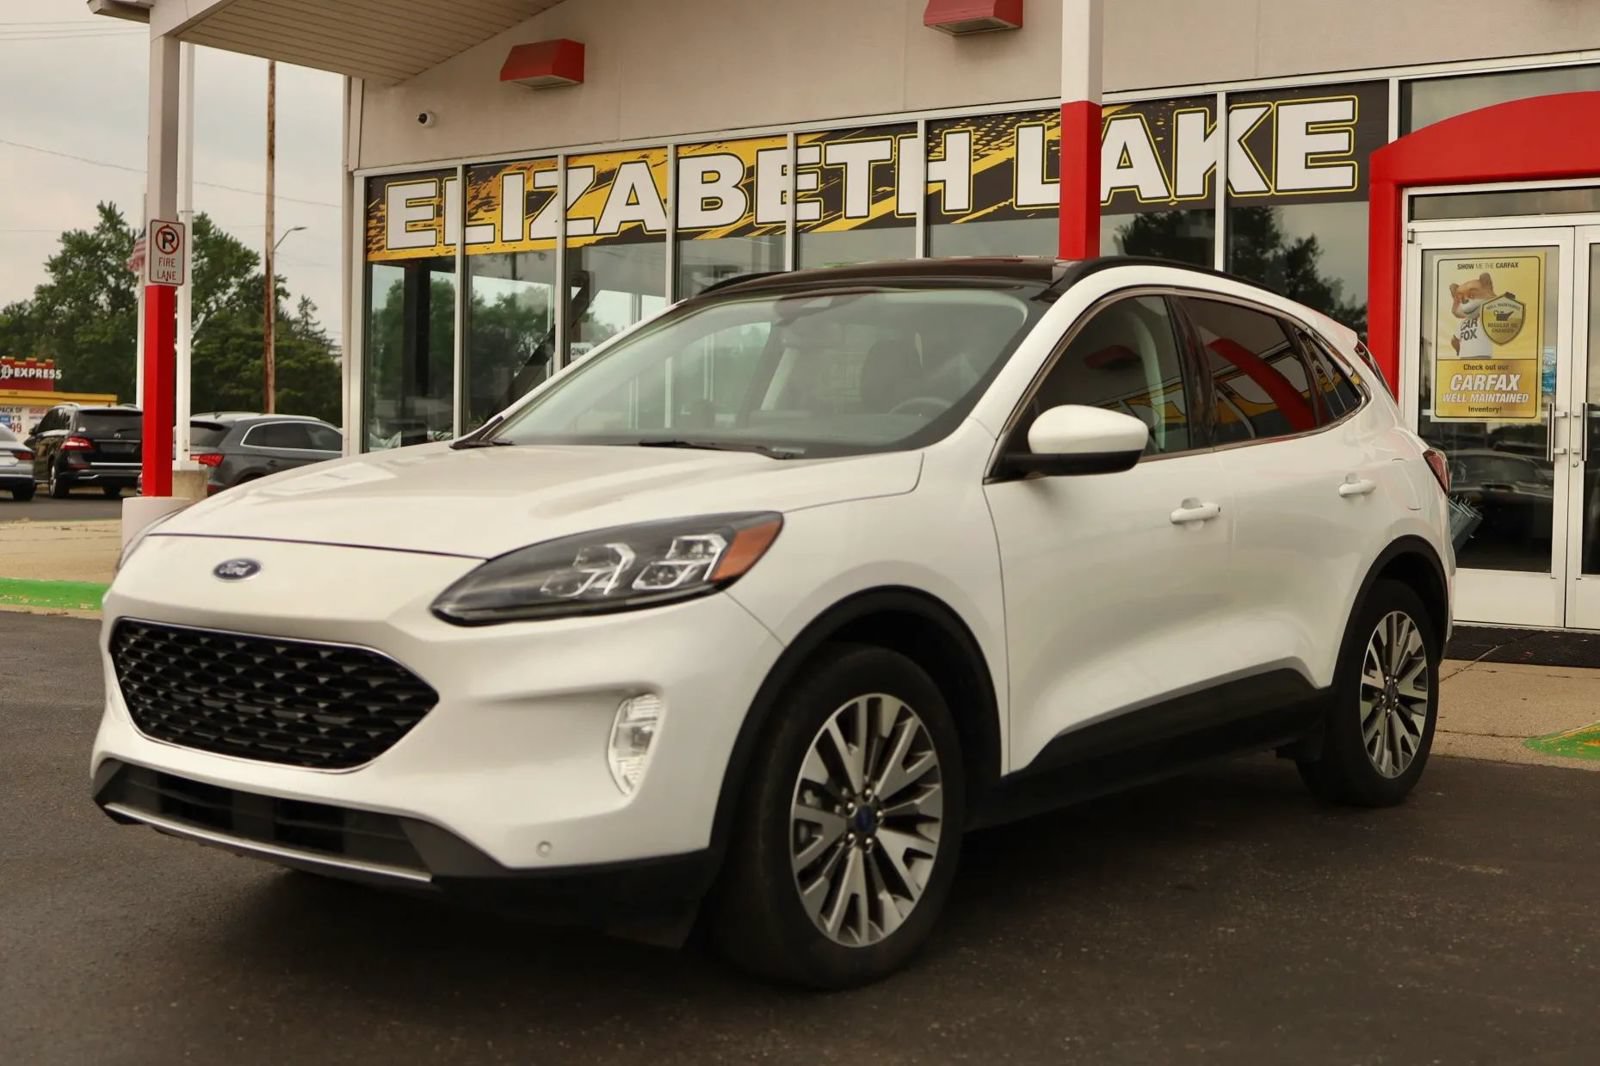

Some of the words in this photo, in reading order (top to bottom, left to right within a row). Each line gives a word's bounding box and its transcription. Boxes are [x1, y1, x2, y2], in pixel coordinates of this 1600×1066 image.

[385, 129, 974, 252] ELIZABETH
[1012, 95, 1358, 210] LAKE
[158, 256, 176, 268] FIRE
[1496, 261, 1519, 269] CARFAX
[156, 269, 177, 281] LANE
[14, 367, 62, 379] EXPRESS
[1450, 373, 1520, 391] CARFAX
[1442, 393, 1467, 403] WELL
[1470, 393, 1529, 403] MAINTAINED
